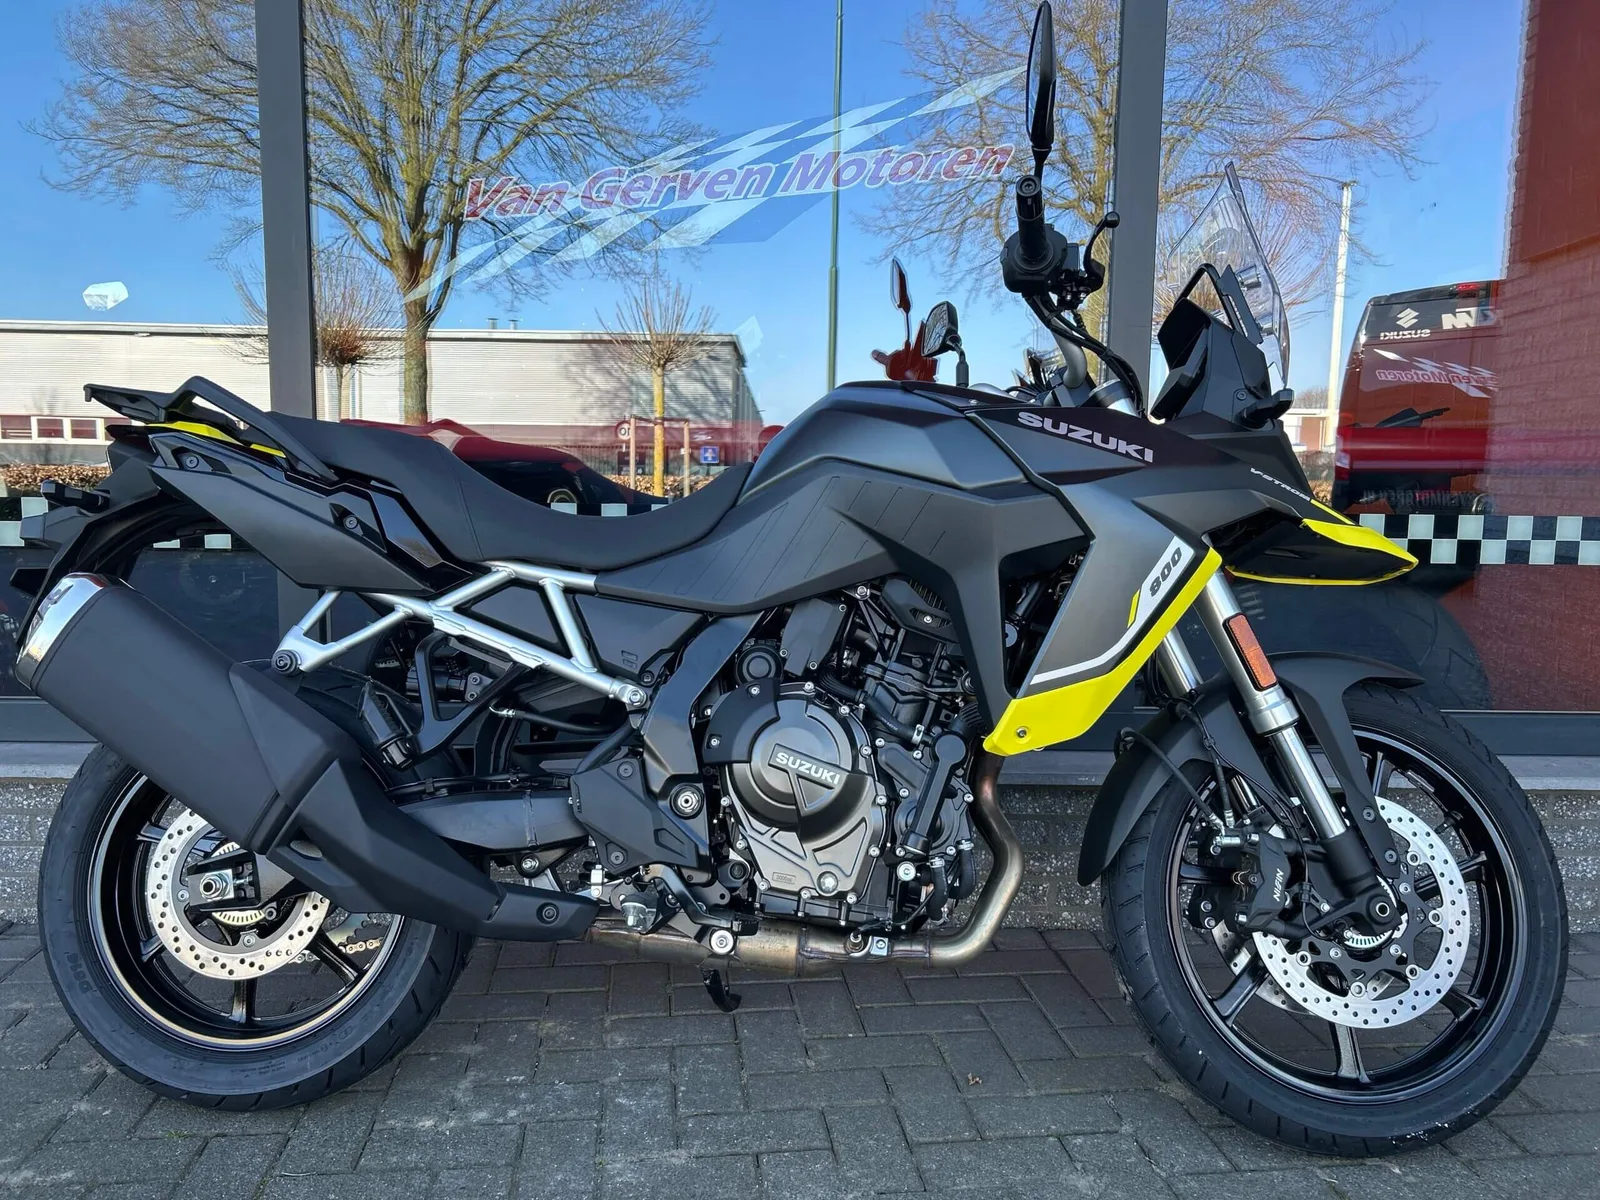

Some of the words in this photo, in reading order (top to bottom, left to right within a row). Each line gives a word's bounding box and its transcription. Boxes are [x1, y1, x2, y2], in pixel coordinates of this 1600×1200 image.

[463, 176, 571, 221] Van
[580, 161, 778, 213] Gerven
[777, 143, 1015, 197] Motoren
[1017, 411, 1154, 463] SUZUKI
[1149, 546, 1183, 598] 800
[775, 752, 841, 785] SUZUKI
